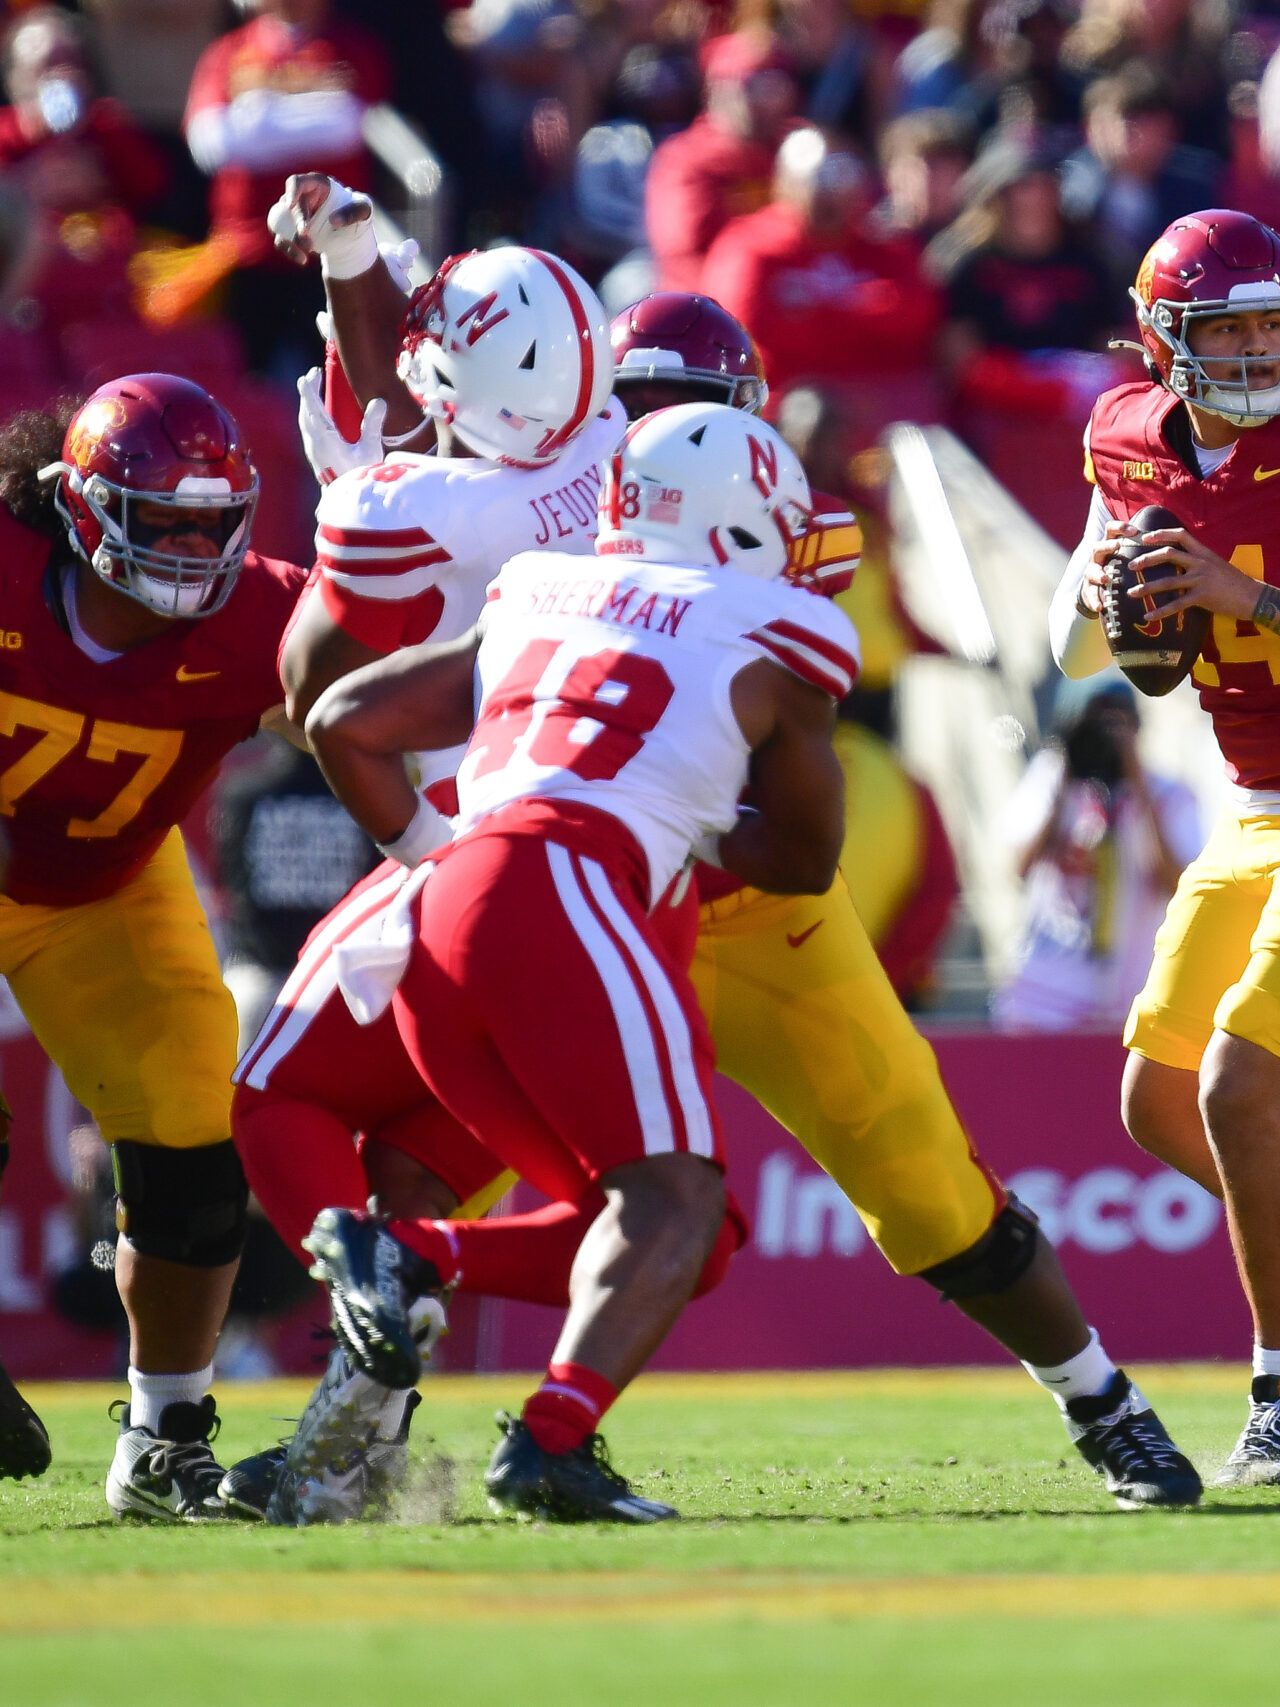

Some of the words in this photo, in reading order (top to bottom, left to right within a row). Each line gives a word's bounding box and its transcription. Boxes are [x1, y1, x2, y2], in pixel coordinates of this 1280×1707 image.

[455, 290, 510, 347] N
[746, 433, 777, 499] N
[524, 580, 692, 638] SHERMAN
[464, 638, 675, 782] 48
[0, 690, 185, 838] 77
[755, 1151, 1224, 1258] Insco
